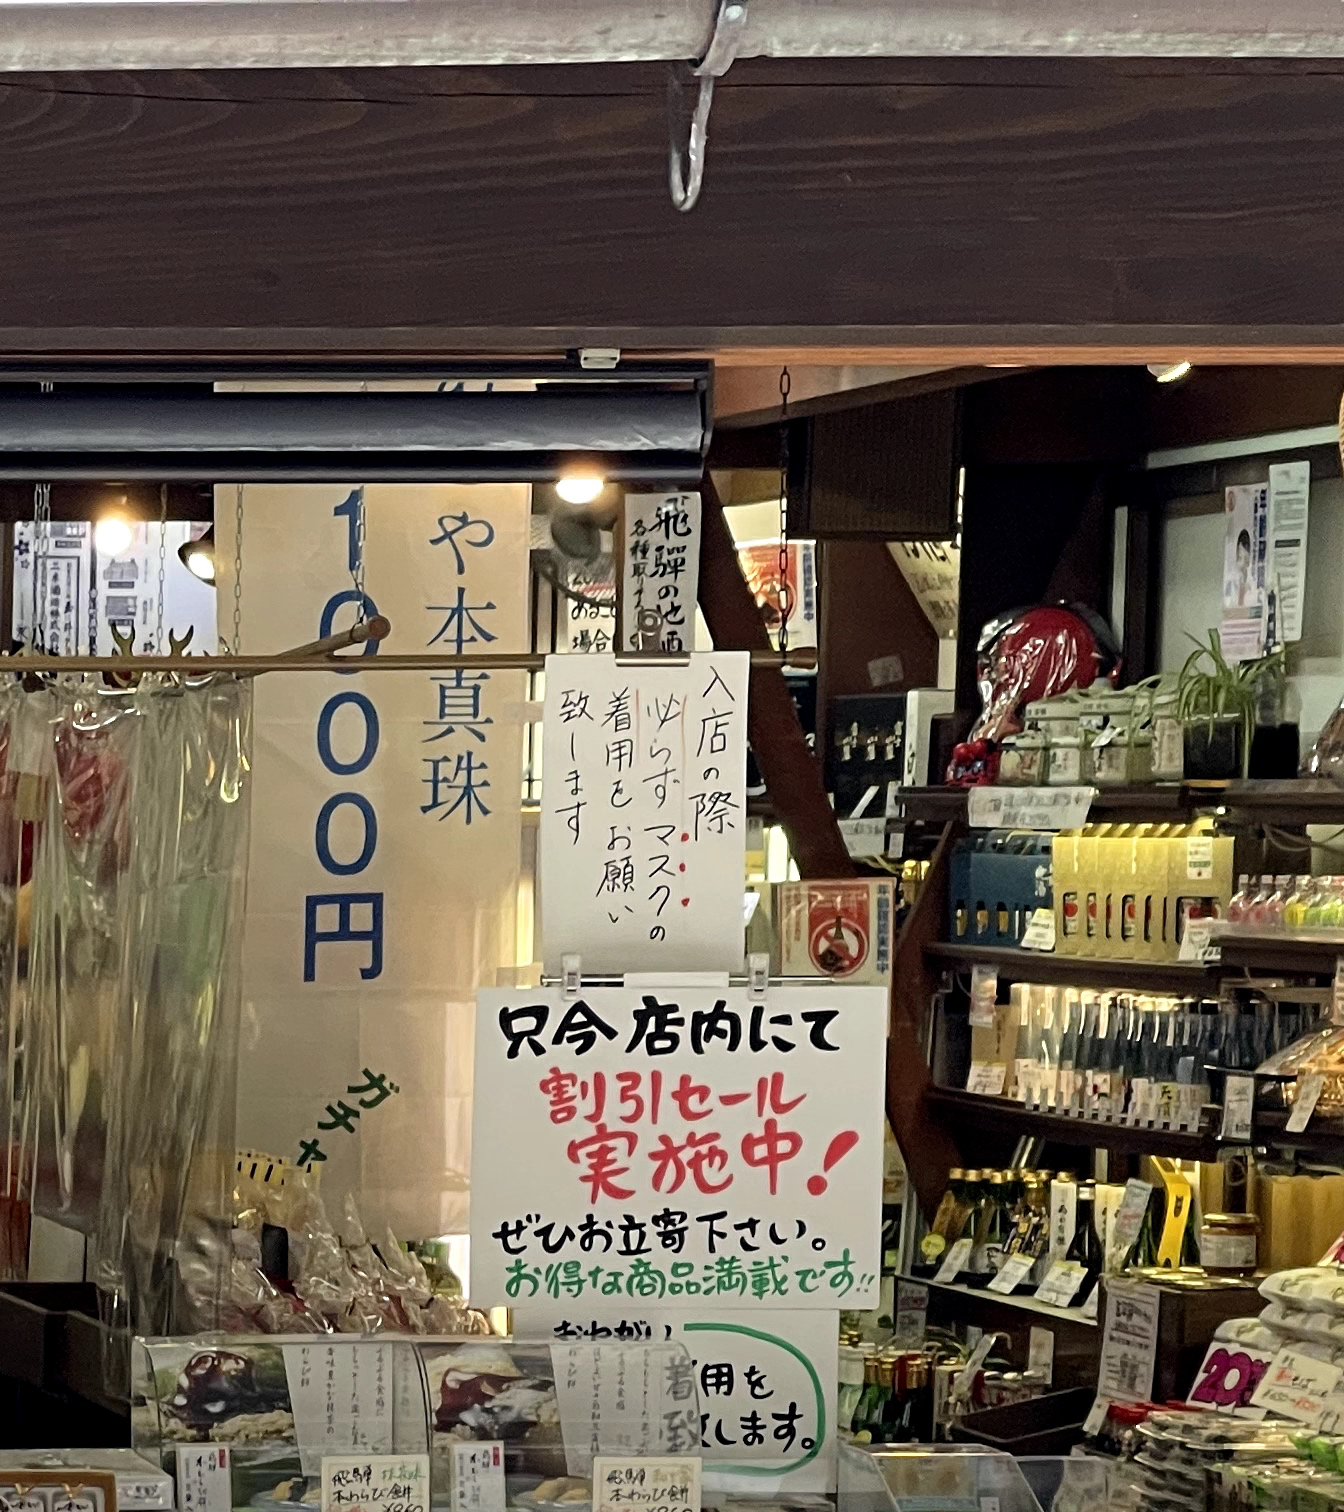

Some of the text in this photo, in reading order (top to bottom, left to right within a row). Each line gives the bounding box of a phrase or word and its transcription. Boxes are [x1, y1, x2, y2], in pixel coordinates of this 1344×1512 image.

[555, 689, 594, 846] 致します
[688, 665, 740, 842] 入店の際
[538, 1066, 807, 1125] 割引セール
[492, 1208, 828, 1257] ぜひお立寄下さい。
